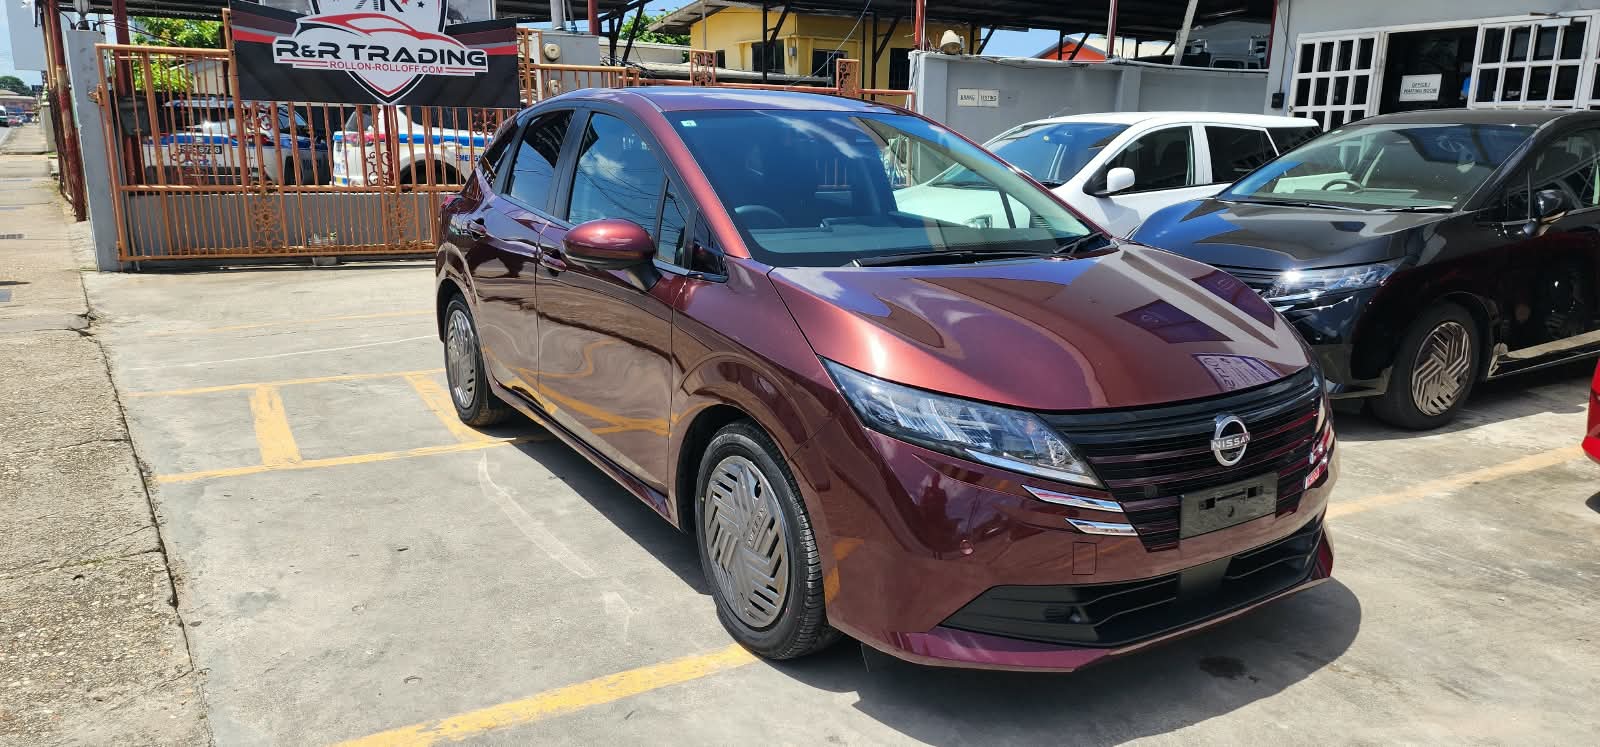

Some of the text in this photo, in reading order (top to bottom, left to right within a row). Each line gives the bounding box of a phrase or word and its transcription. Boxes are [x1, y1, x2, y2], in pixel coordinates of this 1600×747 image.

[276, 39, 487, 66] R&R TRADING
[329, 61, 443, 74] ROLLON-ROLLOFF.COM
[1212, 433, 1248, 449] NISSAN
